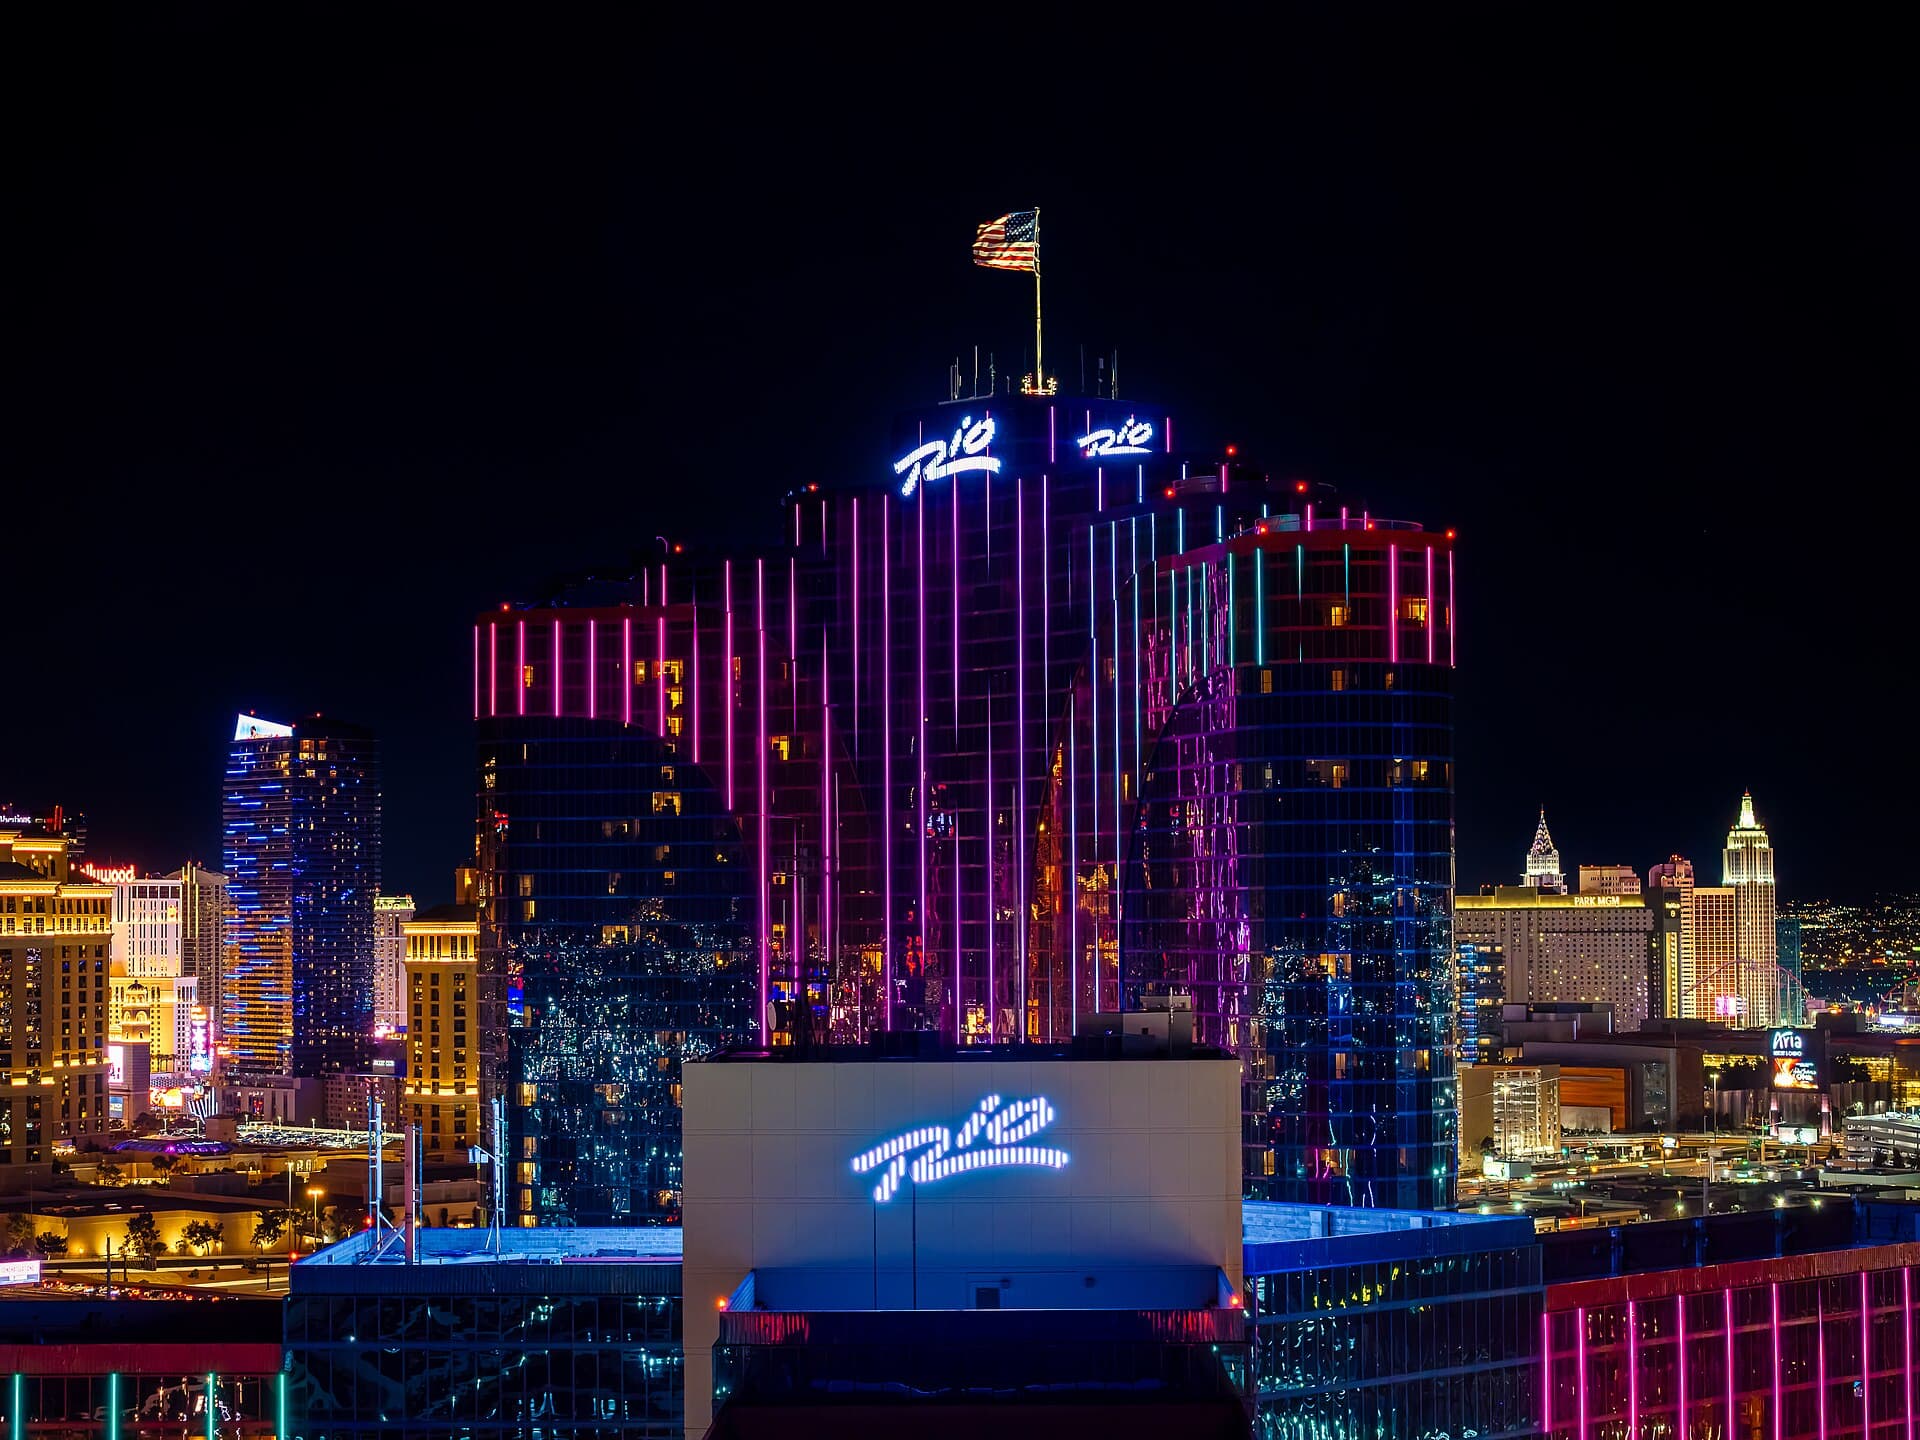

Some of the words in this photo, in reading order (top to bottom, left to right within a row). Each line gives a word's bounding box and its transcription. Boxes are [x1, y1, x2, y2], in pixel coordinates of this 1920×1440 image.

[1077, 419, 1153, 457] Rio
[894, 416, 1001, 496] Rio
[70, 862, 136, 884] llywood
[1574, 896, 1596, 907] PARK
[1597, 896, 1620, 907] MGM
[1773, 1031, 1802, 1050] Aria
[851, 1094, 1068, 1203] Rio
